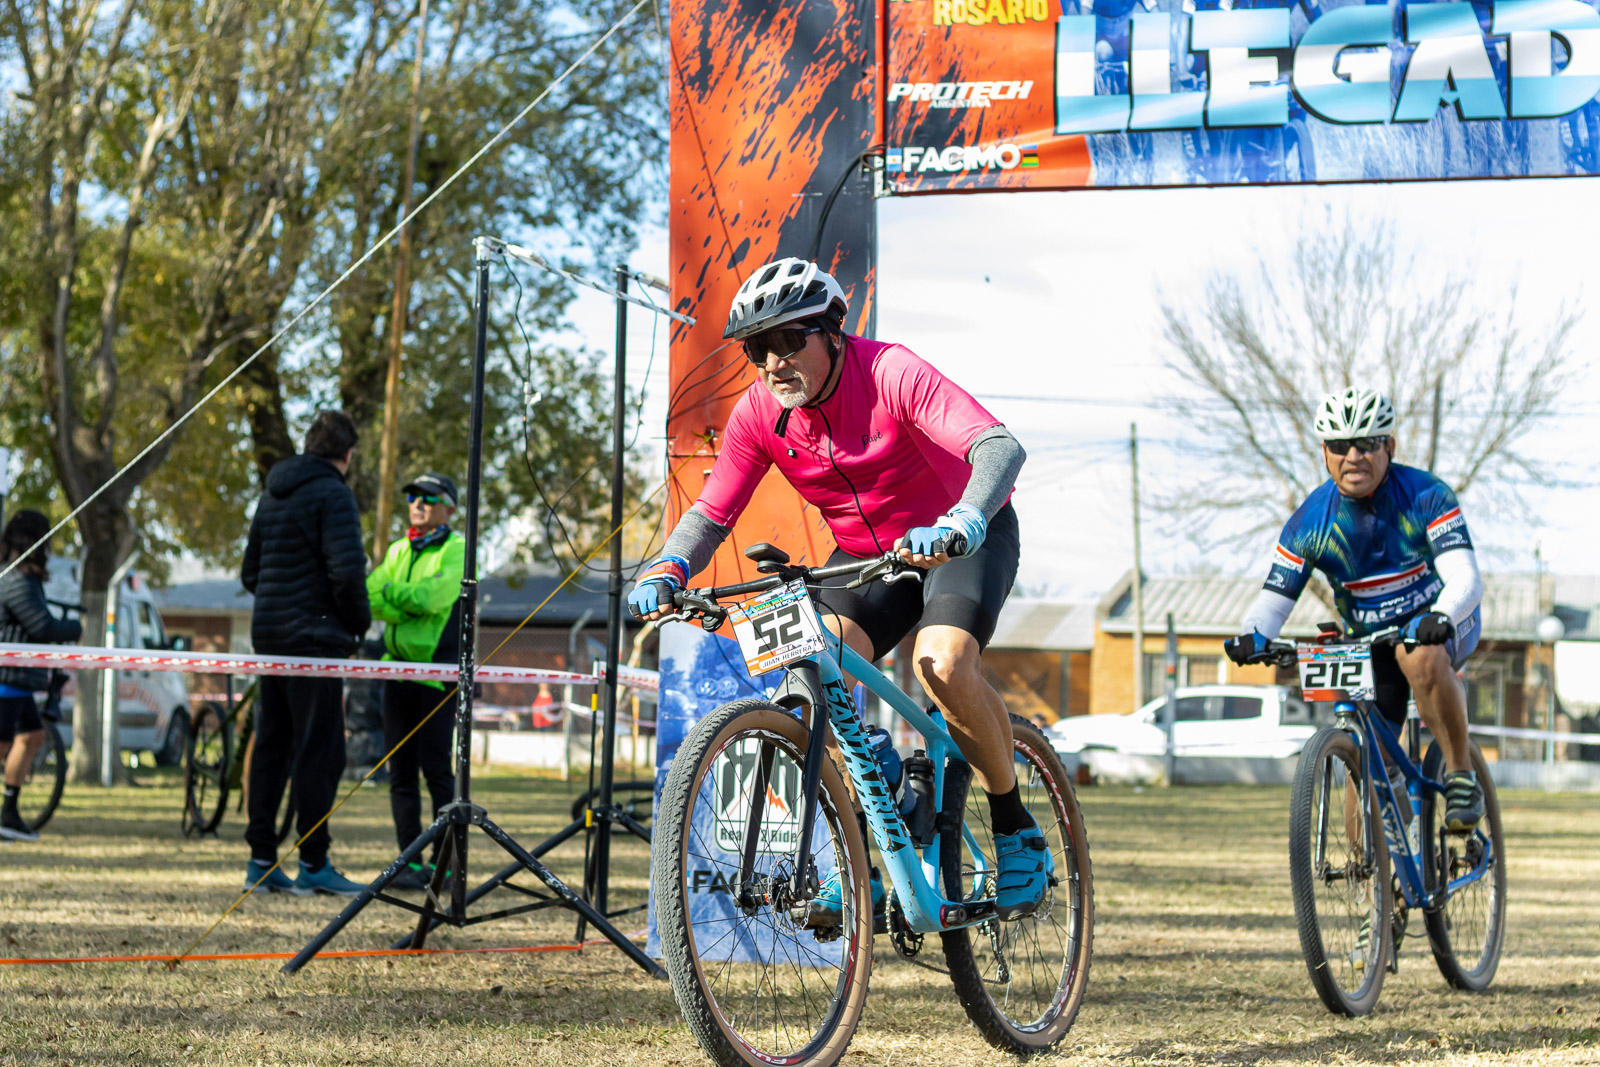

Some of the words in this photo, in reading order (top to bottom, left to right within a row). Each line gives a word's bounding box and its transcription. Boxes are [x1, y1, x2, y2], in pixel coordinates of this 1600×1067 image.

[932, 0, 1049, 26] ROSARIO
[887, 80, 1034, 102] PROTECH
[928, 98, 991, 109] ARGENTINA
[902, 144, 1021, 173] FACIMO
[752, 603, 803, 655] 52
[762, 657, 781, 669] JUAN
[782, 645, 812, 661] HERRERA
[1304, 661, 1363, 688] 212
[1013, 738, 1070, 826] ULCRUM
[771, 829, 798, 843] Ride
